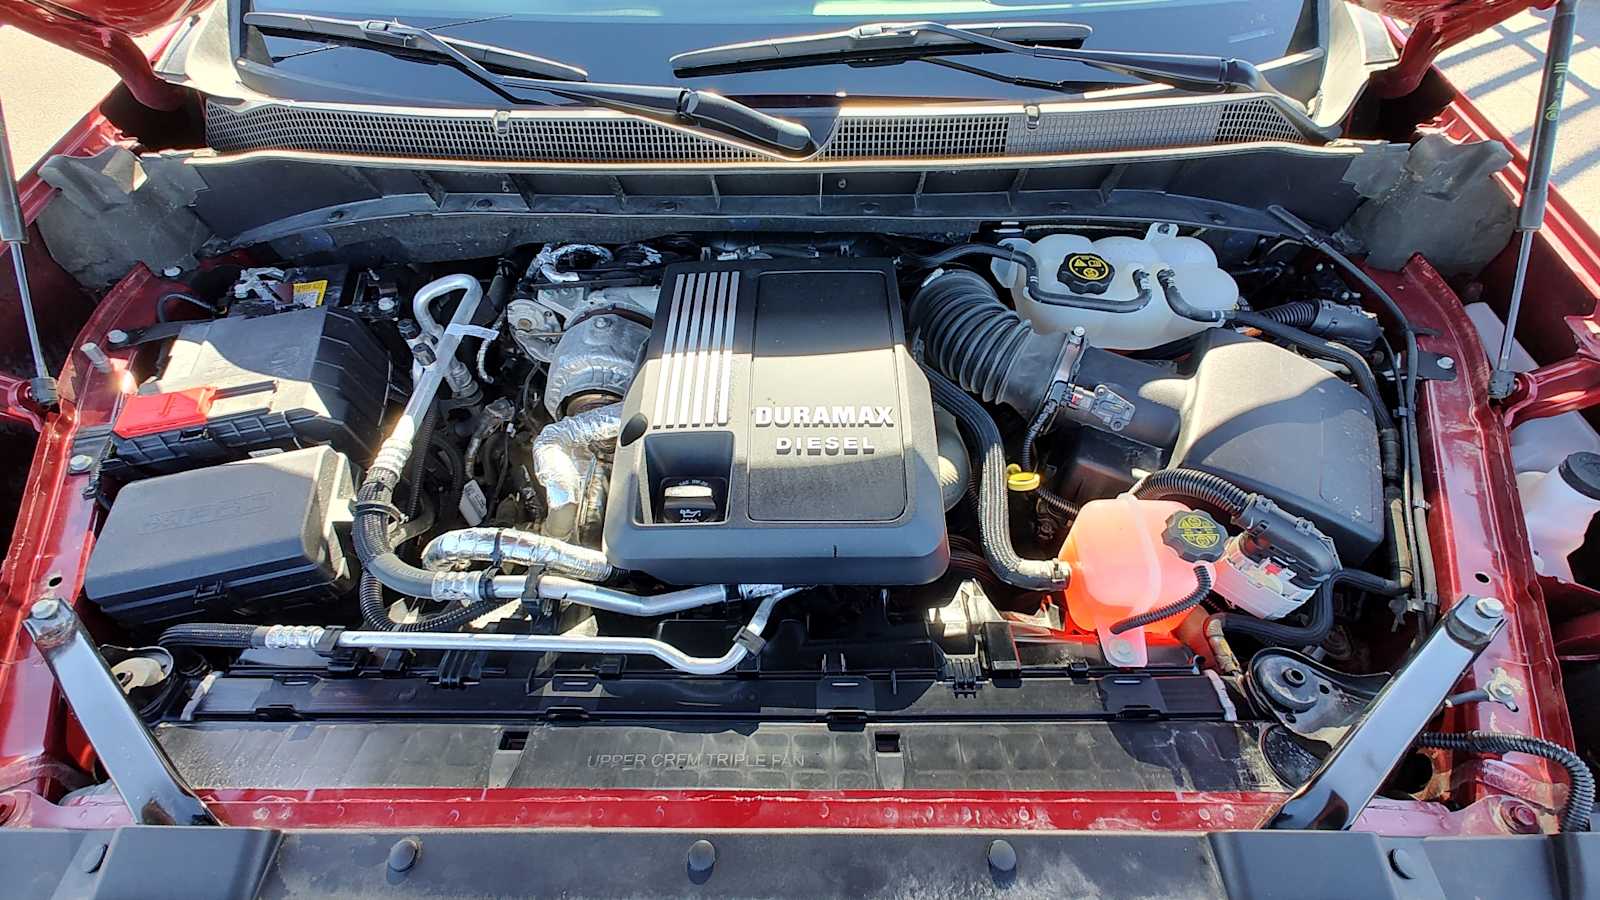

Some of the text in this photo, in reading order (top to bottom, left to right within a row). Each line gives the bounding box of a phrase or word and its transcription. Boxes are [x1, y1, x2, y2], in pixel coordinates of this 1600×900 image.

[755, 406, 894, 428] DURAMAX
[776, 436, 875, 455] DIESEL
[587, 753, 648, 768] UPPER
[705, 753, 768, 768] TRIPLE
[771, 752, 805, 767] FAN
